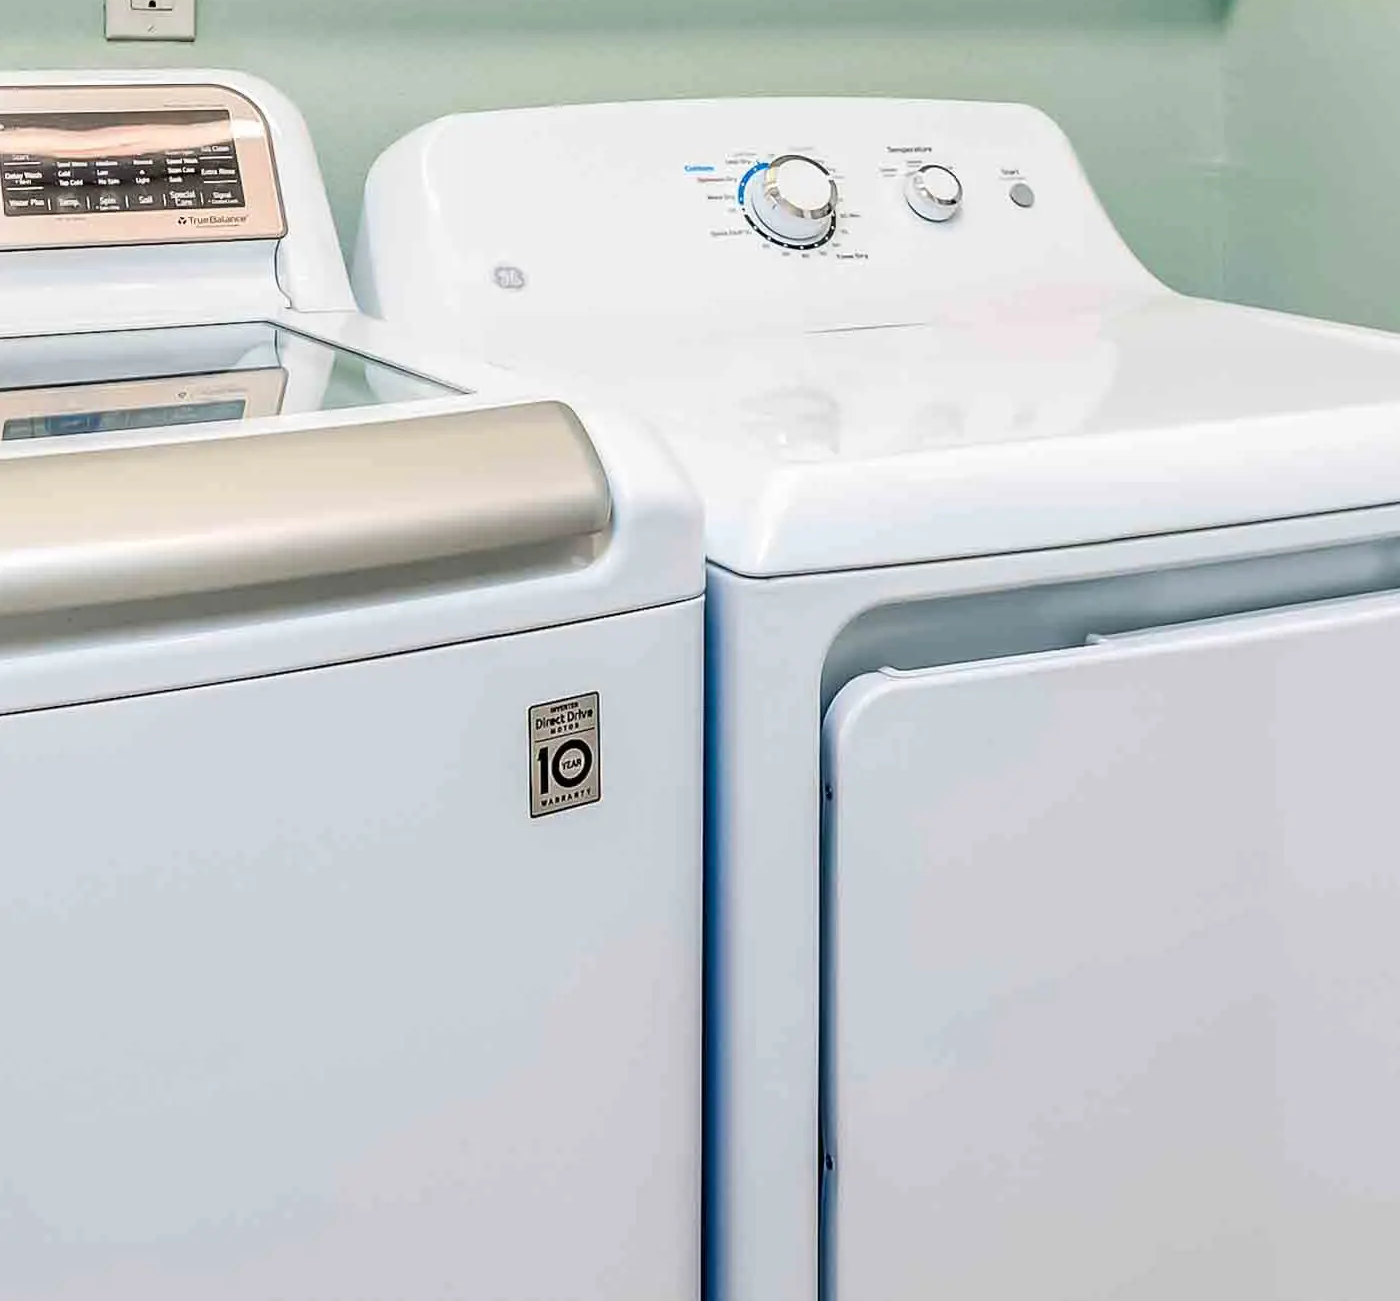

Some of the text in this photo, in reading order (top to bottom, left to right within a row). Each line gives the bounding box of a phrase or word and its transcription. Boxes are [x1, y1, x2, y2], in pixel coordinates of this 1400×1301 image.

[535, 708, 594, 730] Direct Drive
[550, 722, 580, 735] MOTOR
[537, 738, 593, 796] 10
[561, 758, 582, 771] YEAR
[540, 787, 592, 807] WARRANTY
